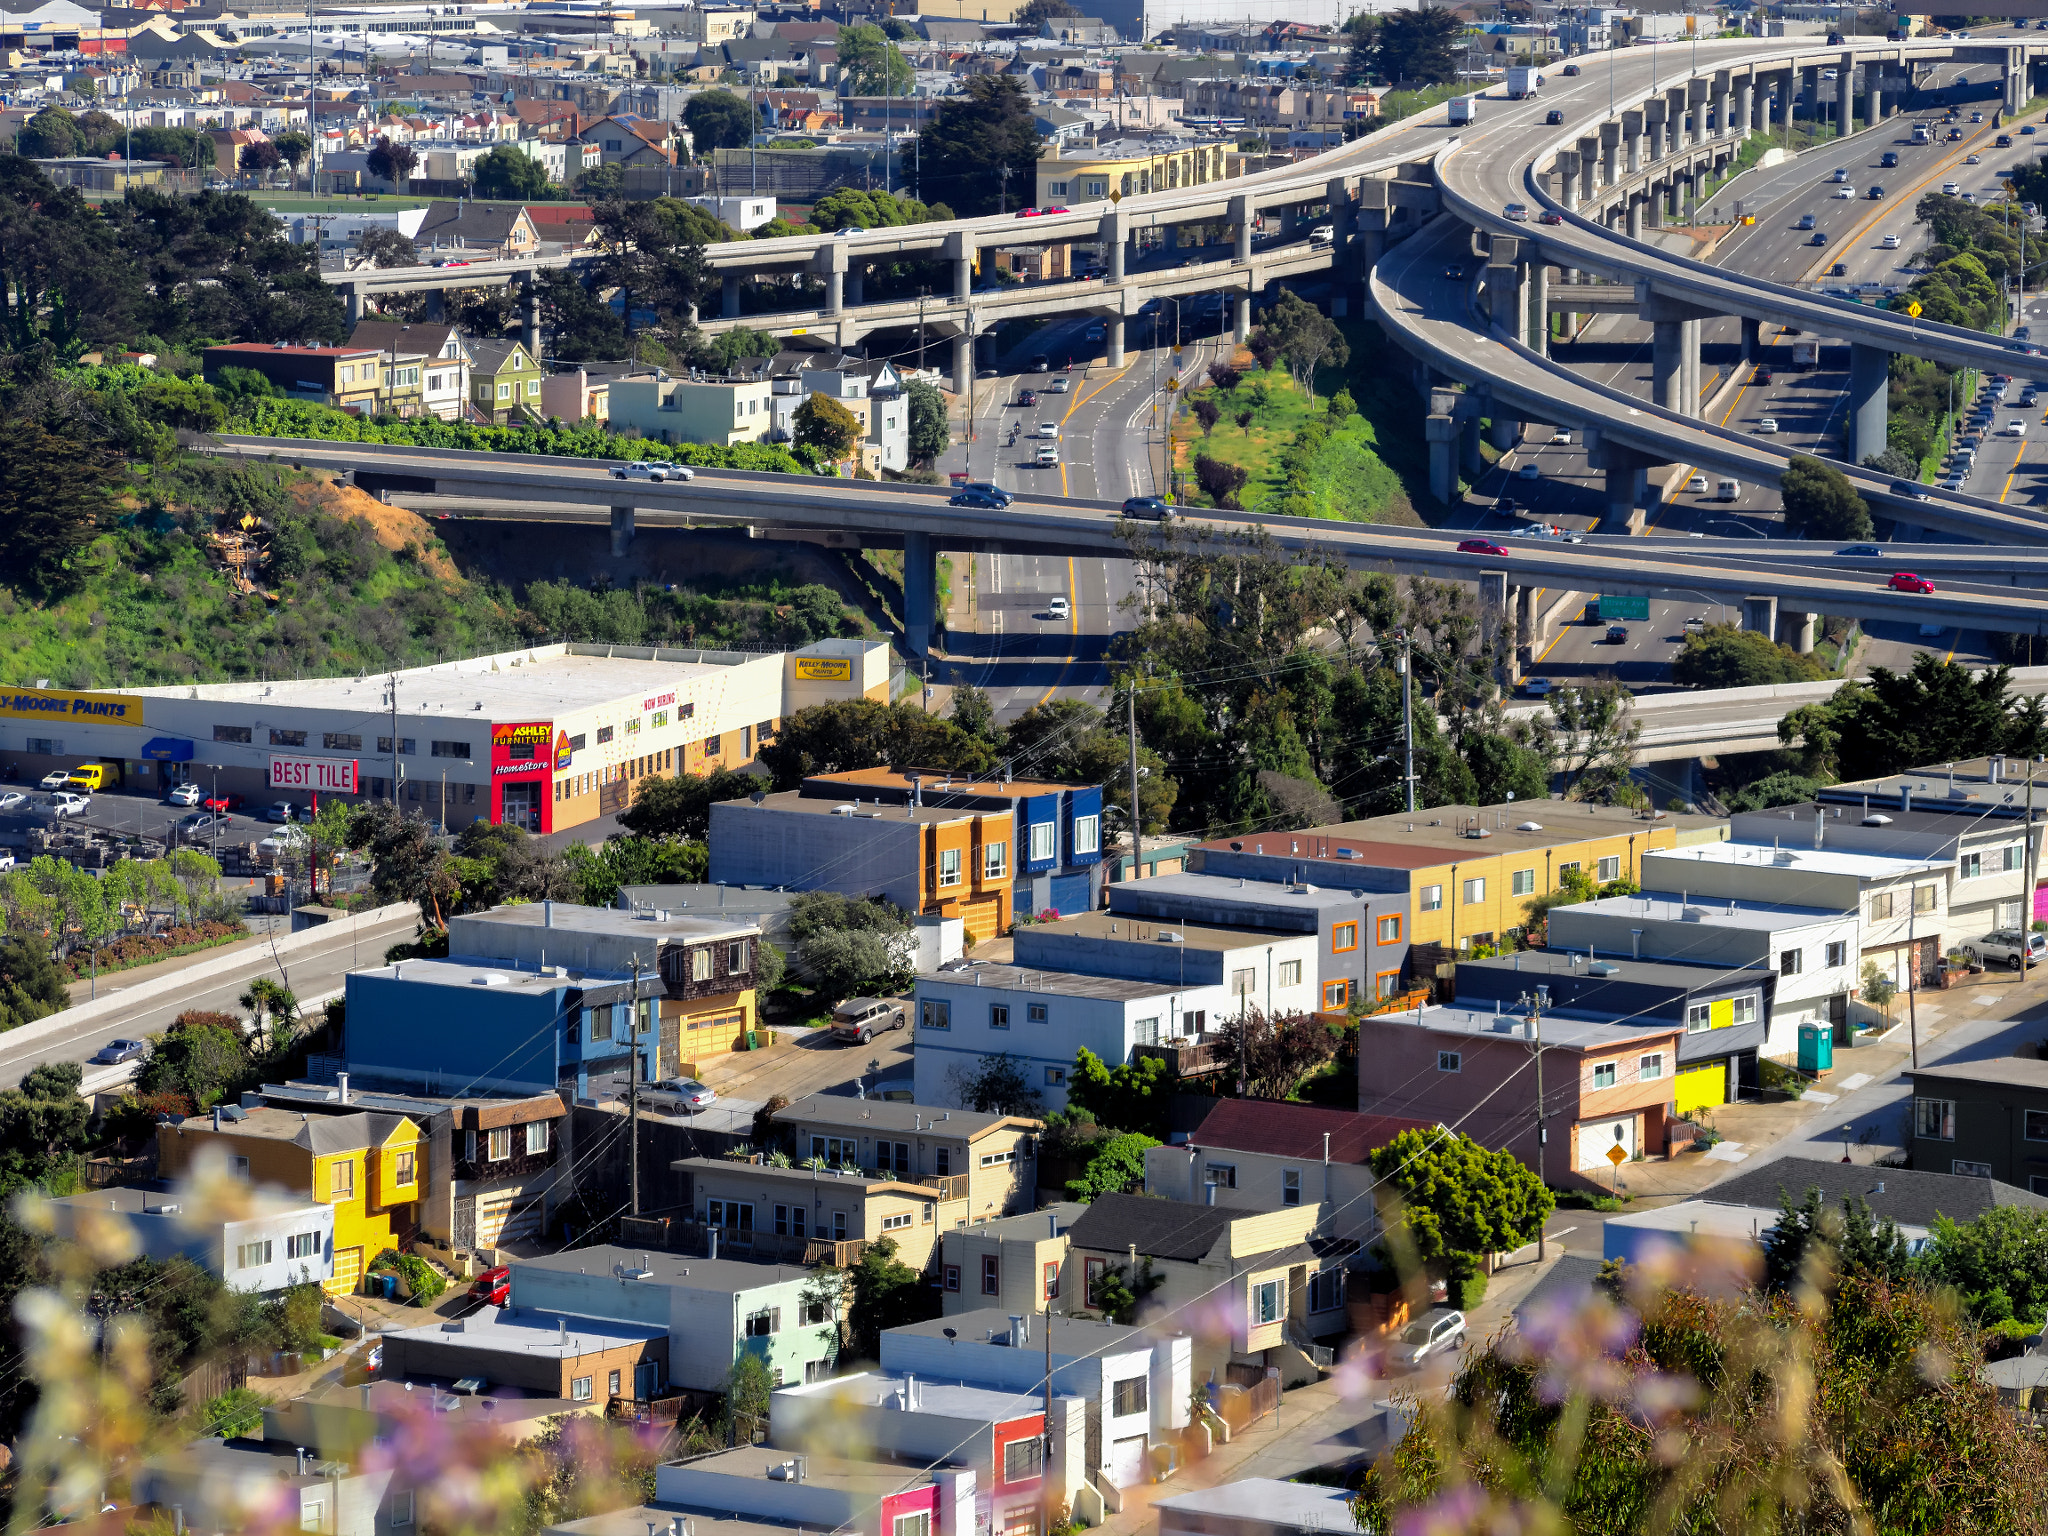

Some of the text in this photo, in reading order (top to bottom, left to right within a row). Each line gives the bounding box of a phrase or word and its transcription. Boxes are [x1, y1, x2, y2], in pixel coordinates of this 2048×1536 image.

[72, 699, 126, 716] PAINTS
[644, 692, 675, 711] NOW HIRING
[513, 726, 552, 736] ASHLEY
[493, 736, 551, 745] FURNITURE
[273, 762, 350, 787] BEST TILE
[495, 762, 548, 774] HomeStore
